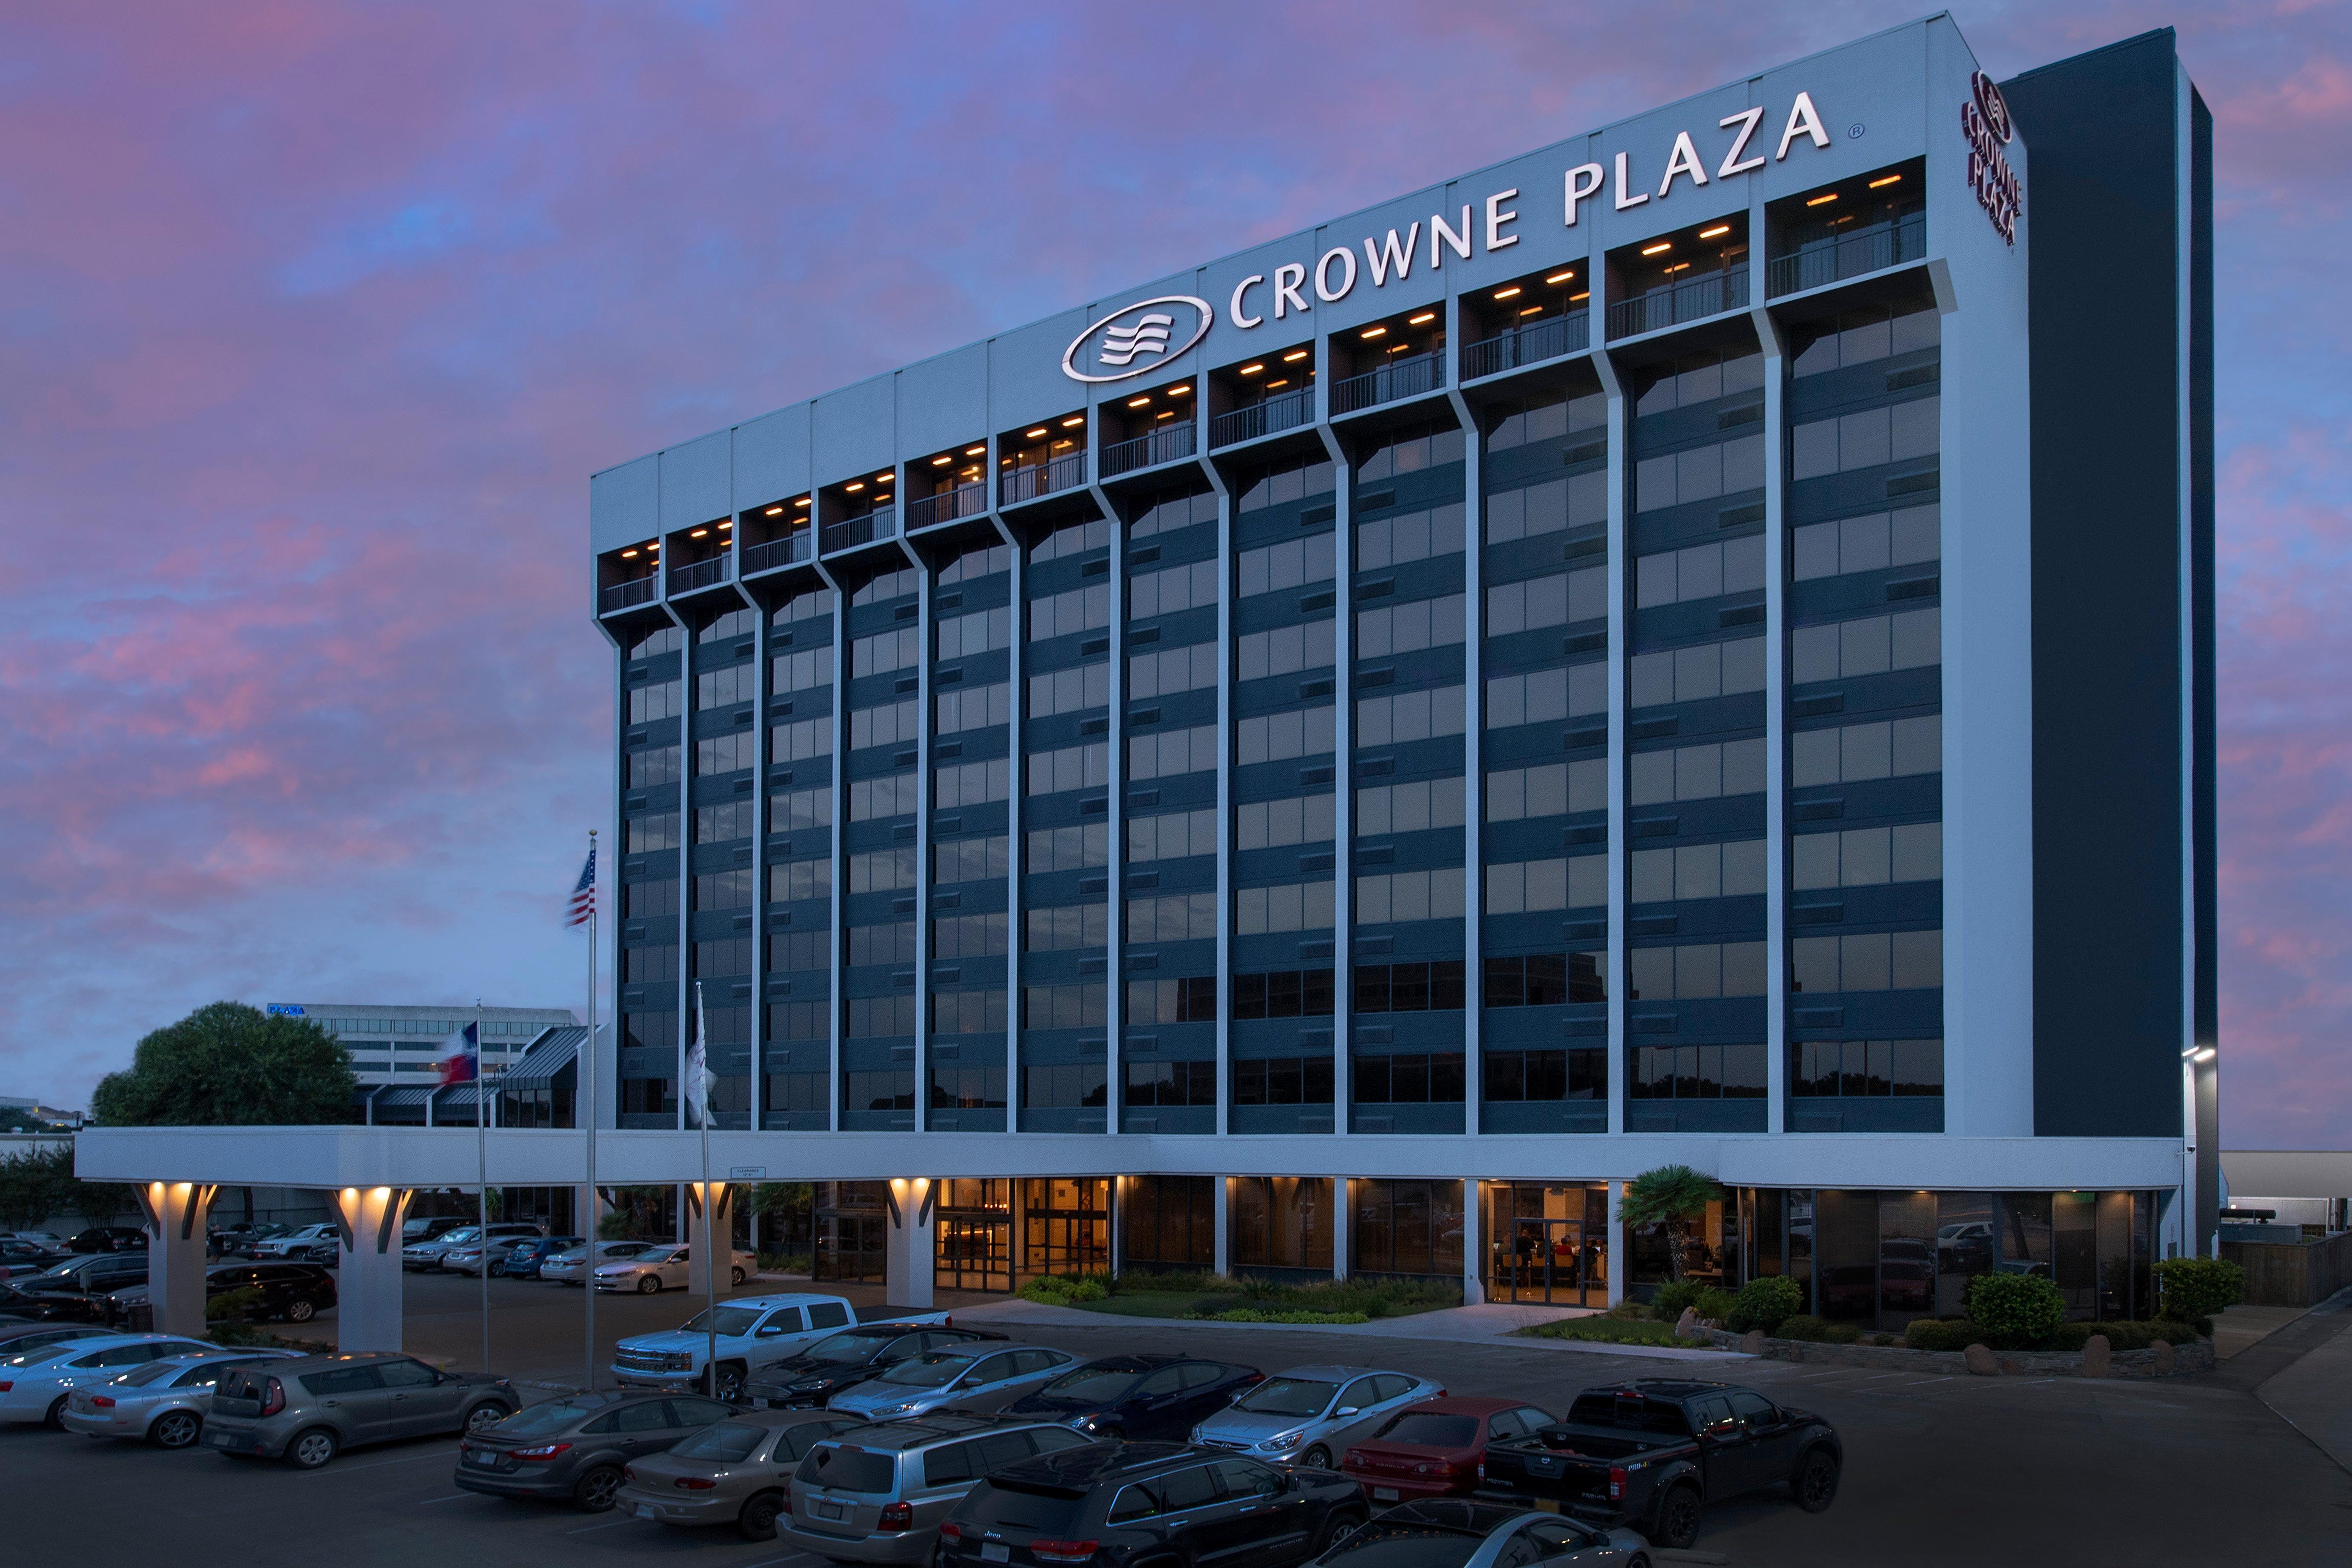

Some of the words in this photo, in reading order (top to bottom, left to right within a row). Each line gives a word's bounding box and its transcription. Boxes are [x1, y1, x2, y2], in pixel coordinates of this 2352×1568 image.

[1230, 188, 1519, 329] CROWNE
[1565, 91, 1831, 226] PLAZA
[1961, 101, 2022, 215] CROWNE
[1968, 152, 2015, 247] PLAZA
[984, 1530, 1001, 1540] Jeep
